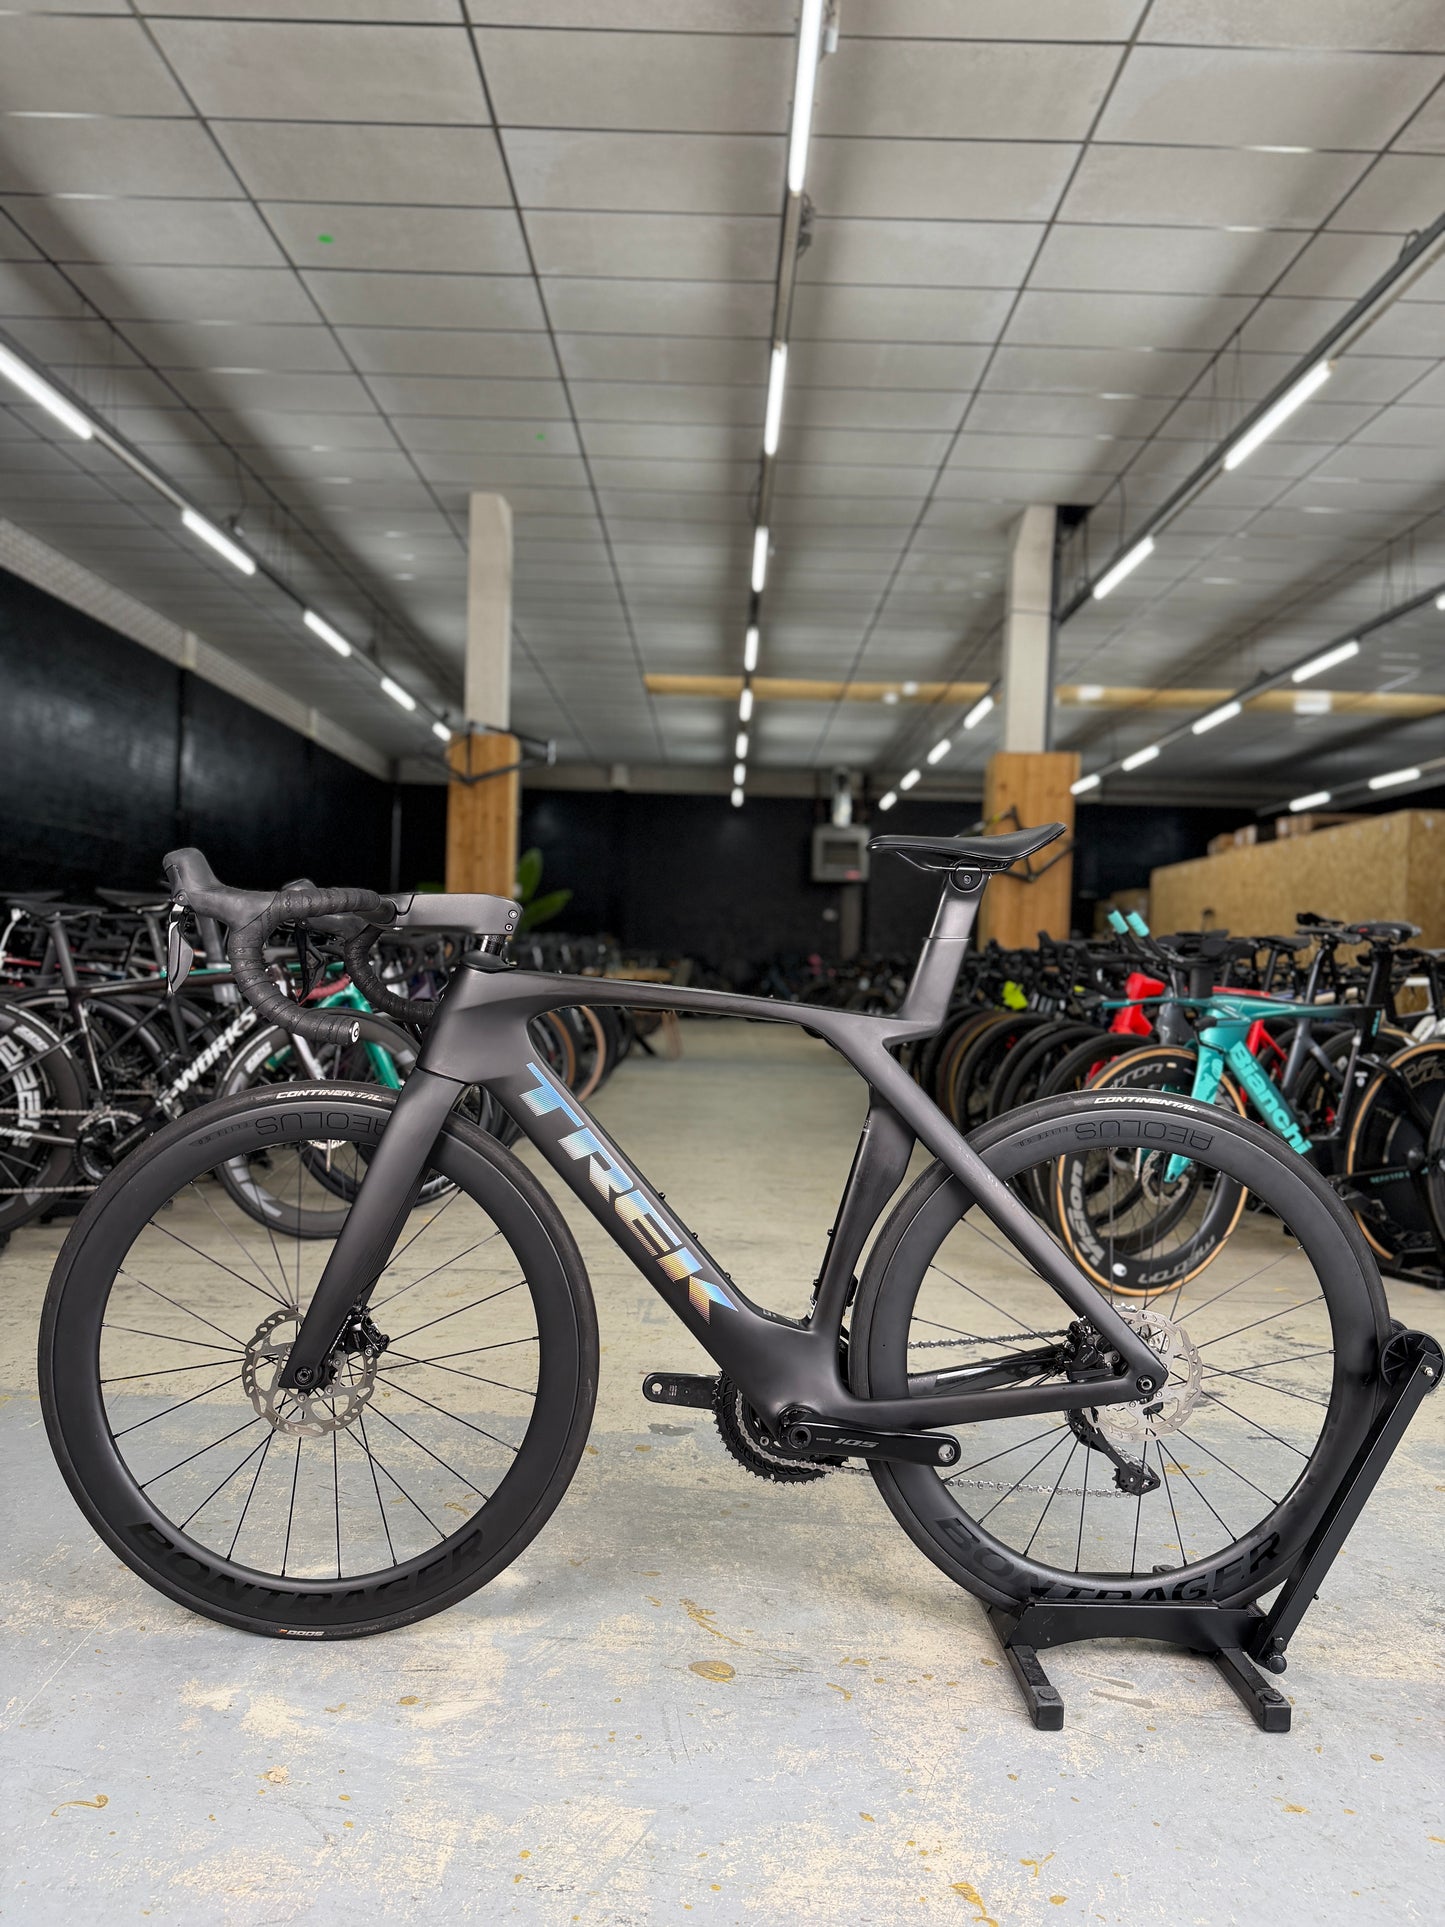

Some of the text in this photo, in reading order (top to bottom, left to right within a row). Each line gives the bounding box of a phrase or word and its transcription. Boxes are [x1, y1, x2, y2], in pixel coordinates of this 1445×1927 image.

[276, 1089, 383, 1101] CONTINENTAL
[1094, 1096, 1199, 1112] CONTINENTAL
[1229, 1041, 1313, 1155] Bianchi
[1075, 1119, 1215, 1150] AEOLUS
[519, 1063, 739, 1326] TREK
[834, 1437, 880, 1449] 105
